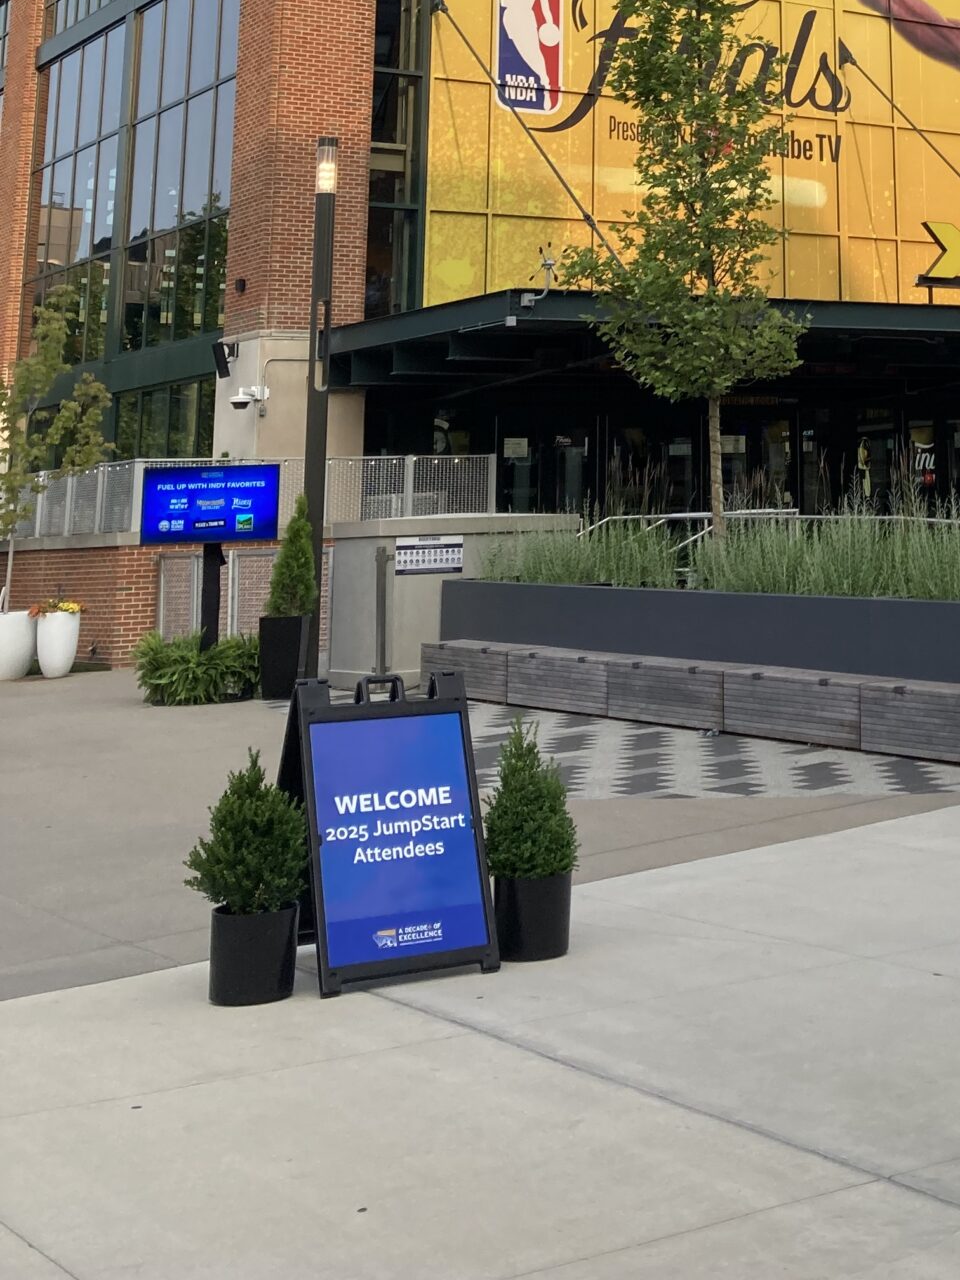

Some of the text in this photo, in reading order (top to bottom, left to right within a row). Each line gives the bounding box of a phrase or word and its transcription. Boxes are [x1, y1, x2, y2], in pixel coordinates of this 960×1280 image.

[504, 73, 538, 103] NBA
[816, 133, 842, 163] TV
[157, 483, 175, 491] FUEL
[177, 483, 187, 491] UP
[188, 482, 208, 490] WITH
[227, 480, 266, 489] FAVORITES
[334, 785, 452, 815] WELCOME
[325, 813, 466, 842] 2025 JumpStart
[353, 841, 445, 864] Attendees
[398, 929, 443, 942] EXCELLENCE
[433, 922, 442, 930] OF
